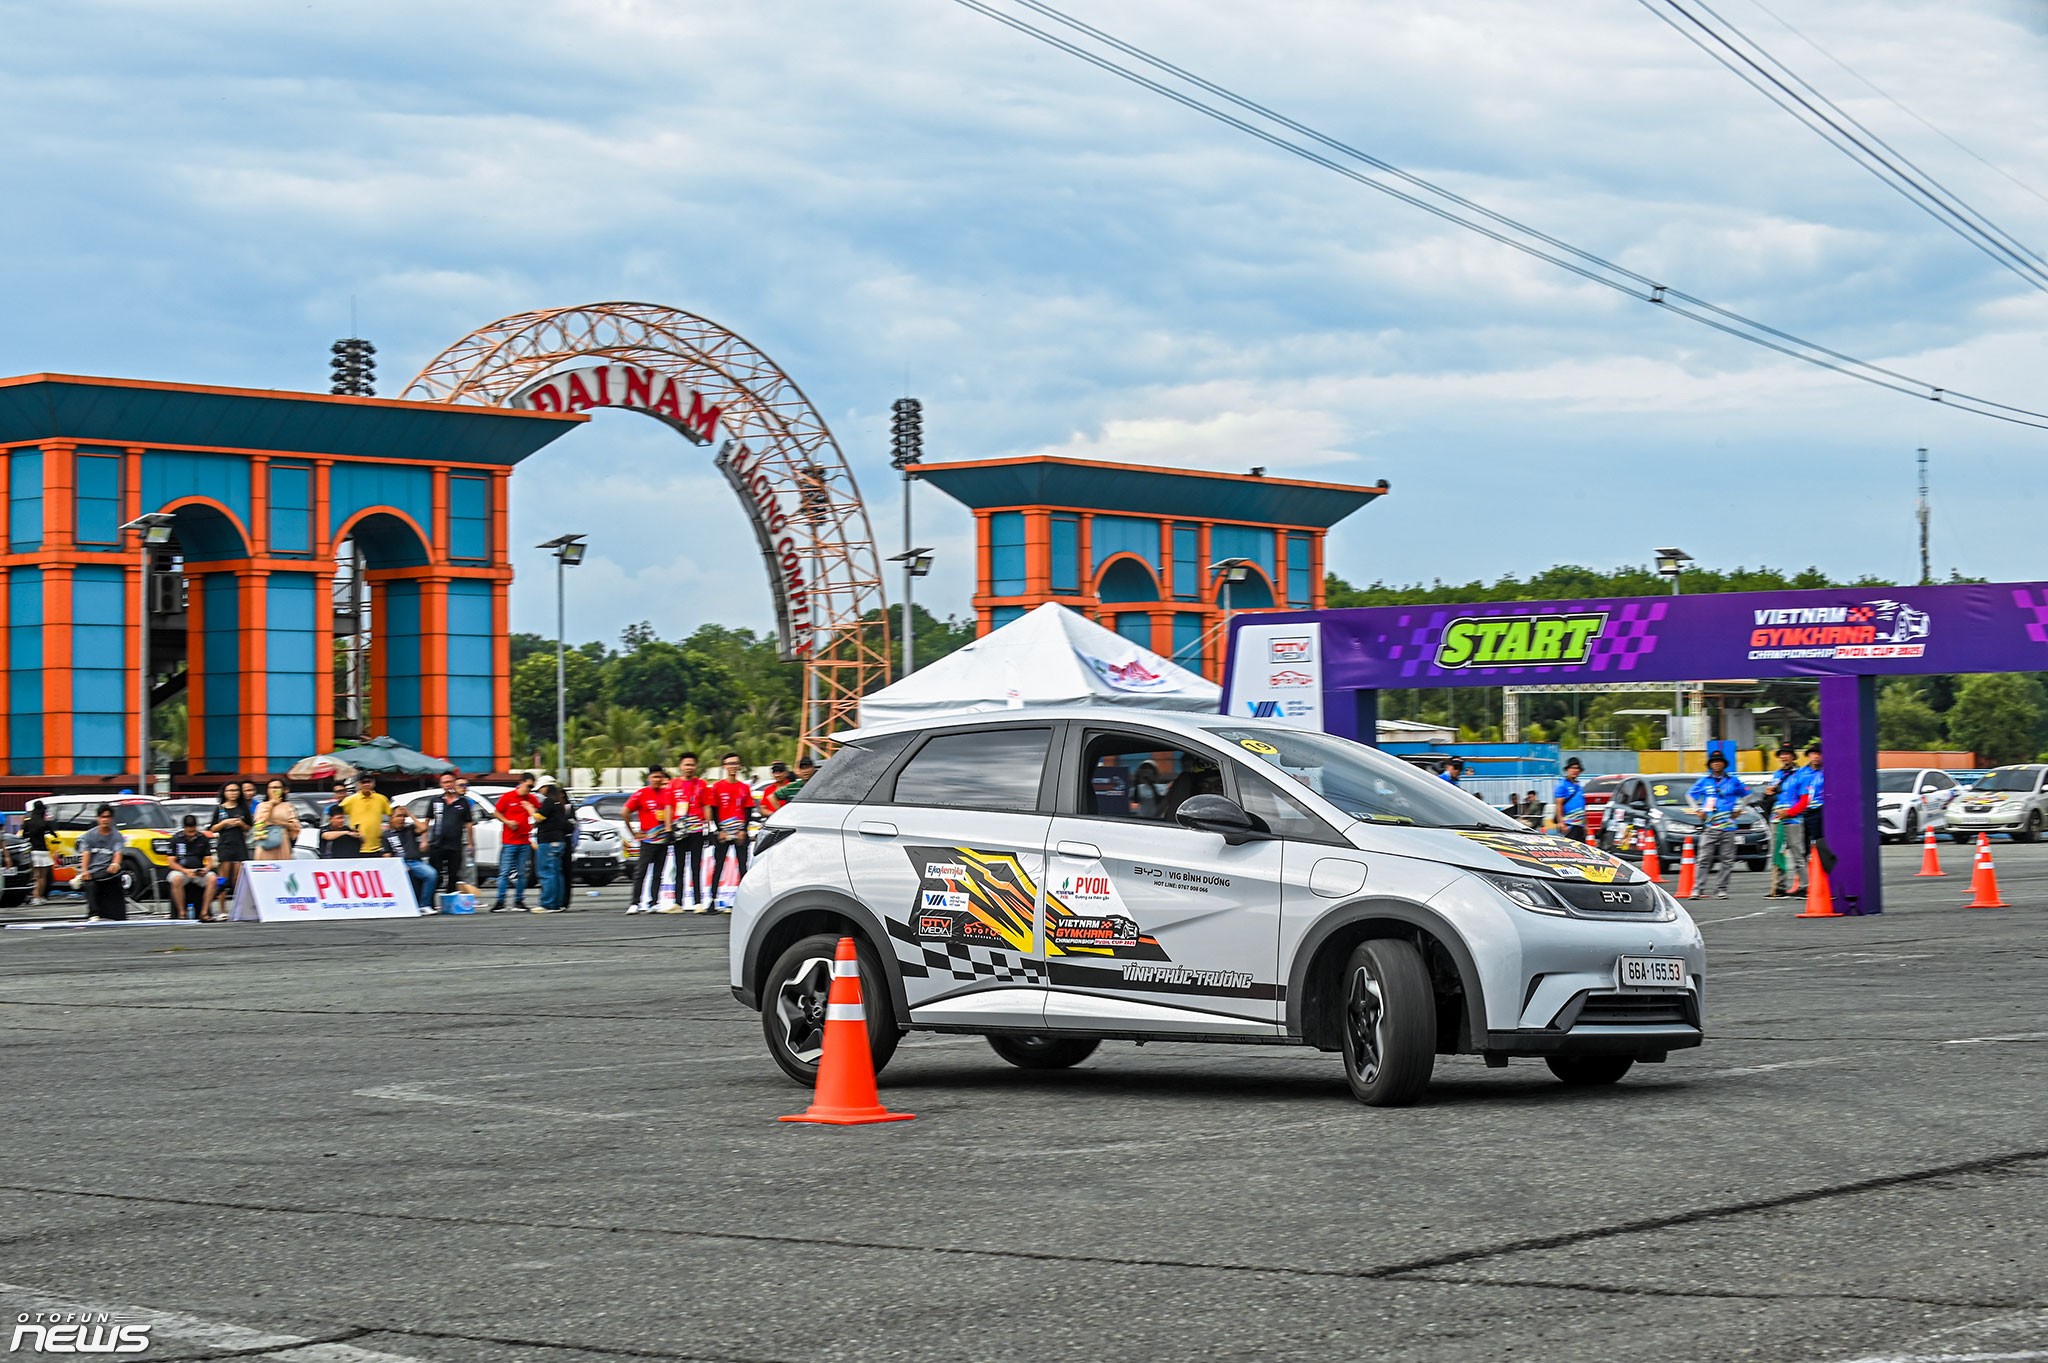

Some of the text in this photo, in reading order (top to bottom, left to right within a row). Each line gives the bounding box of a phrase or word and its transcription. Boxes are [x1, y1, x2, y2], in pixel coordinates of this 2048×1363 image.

[625, 366, 722, 443] NAM
[732, 444, 814, 655] RACING COMPLEX
[1754, 607, 1848, 625] VIETNAM
[1439, 618, 1601, 663] START
[1750, 626, 1876, 647] GYMKHANA
[1748, 648, 1836, 659] CHAMPIONSHIP
[1836, 647, 1870, 657] PVOIL
[1872, 647, 1895, 656] CUP
[312, 870, 394, 899] PVOIL
[1075, 877, 1110, 894] PVOIL
[1134, 867, 1230, 887] BYD VIG BÌNH DƯƠNG
[1602, 891, 1632, 903] BYD
[921, 927, 949, 936] MEDIA
[1058, 919, 1100, 928] VIETNAM
[1056, 928, 1113, 939] GYMKHANA
[1122, 962, 1154, 981] VĨNH
[1155, 965, 1193, 985] PHÚC
[1628, 962, 1680, 981] 66A-155.53
